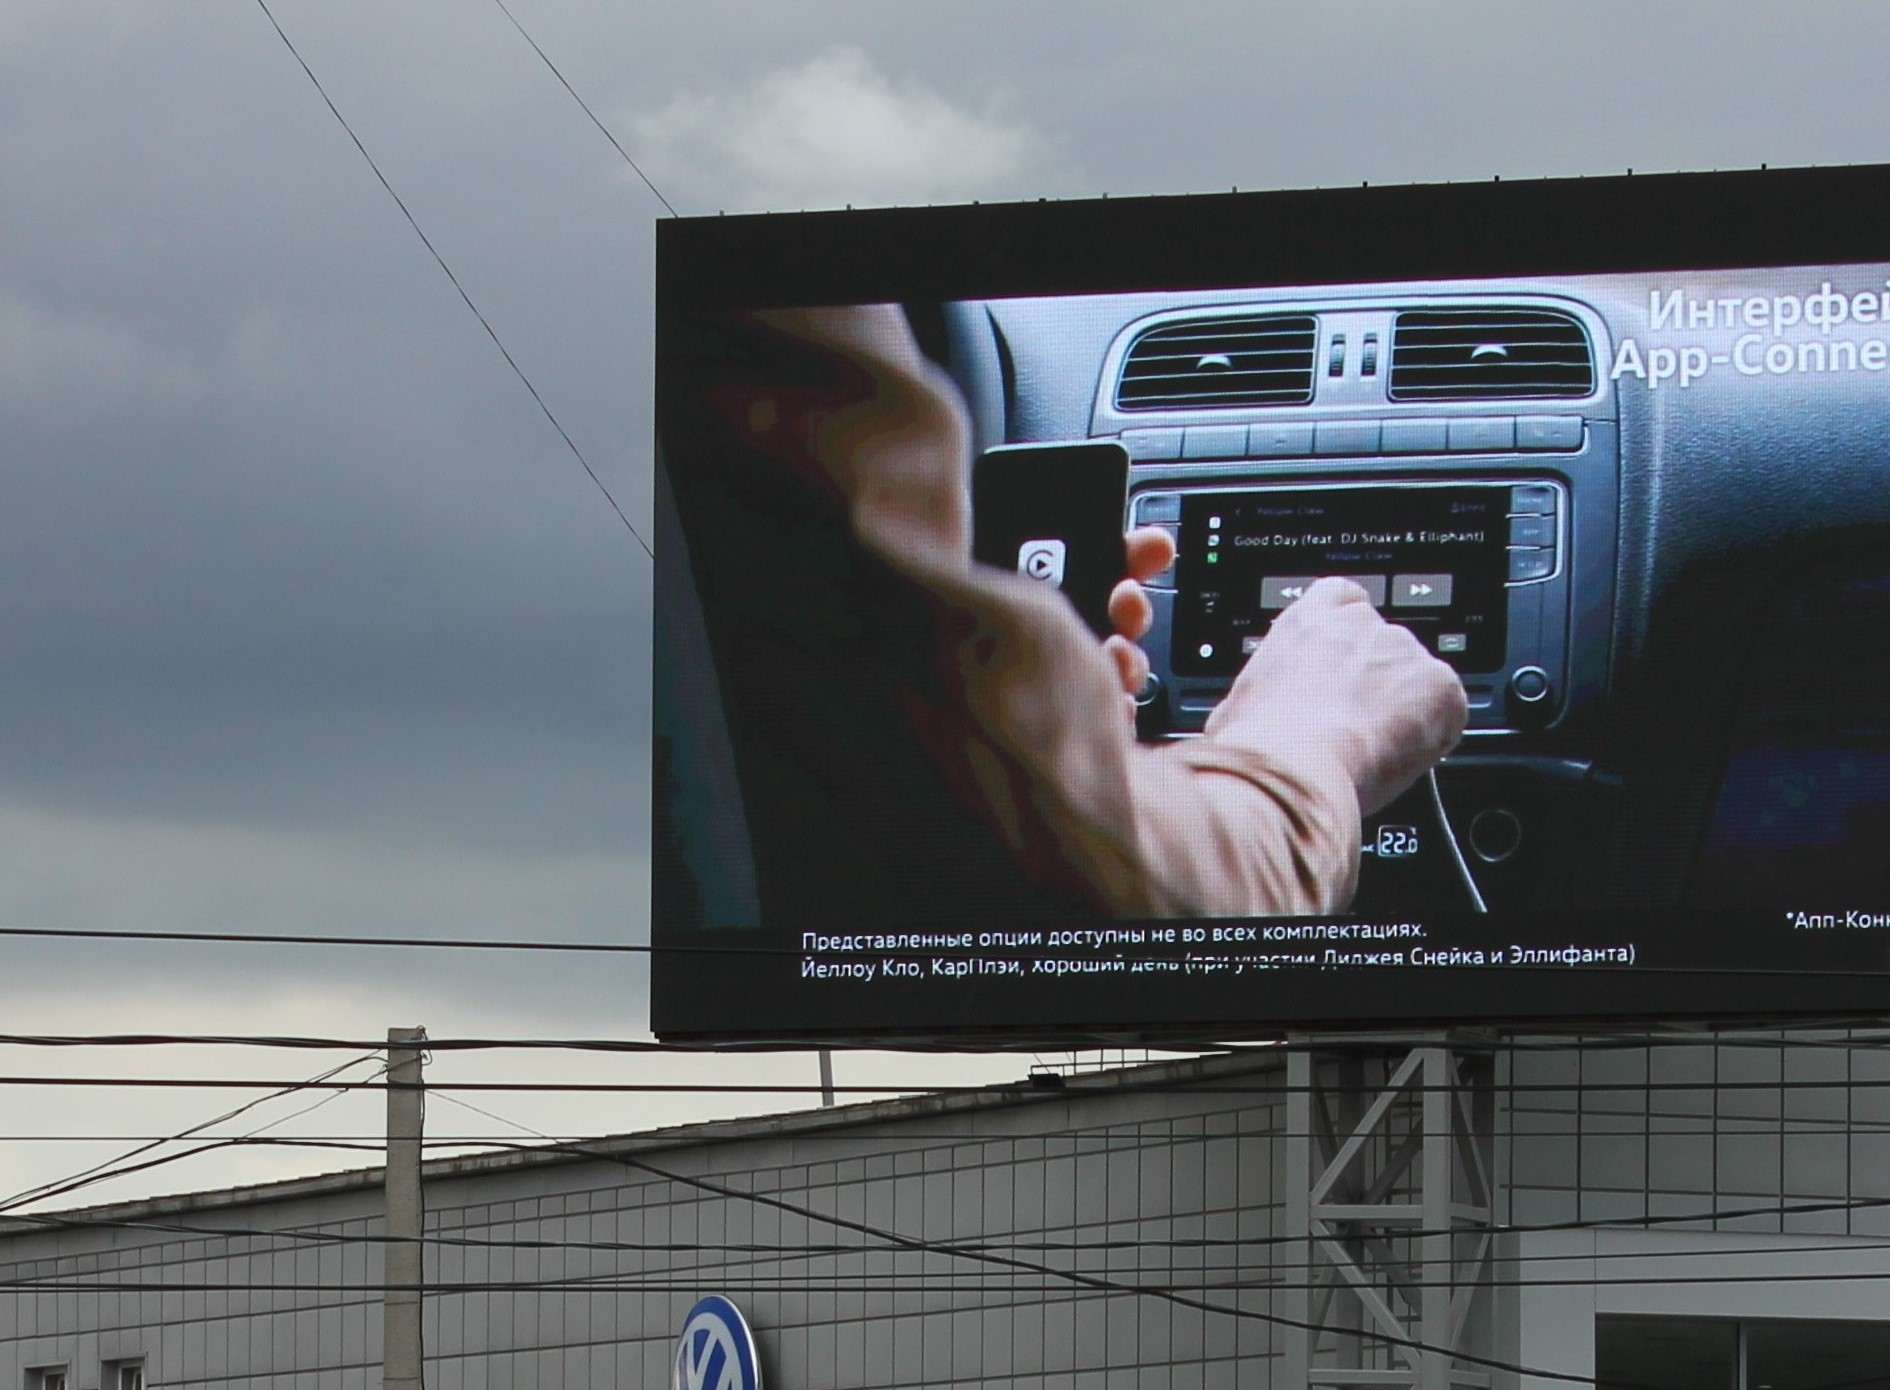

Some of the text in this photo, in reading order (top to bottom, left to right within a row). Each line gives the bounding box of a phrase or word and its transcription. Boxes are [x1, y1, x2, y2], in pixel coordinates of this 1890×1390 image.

[802, 922, 1427, 951] Представленные опции доступны не во всех комплектациях.
[801, 956, 876, 982] Йеллоу
[1410, 946, 1484, 966] Снейка
[1490, 949, 1503, 964] и
[1509, 943, 1636, 967] Эллифанта)
